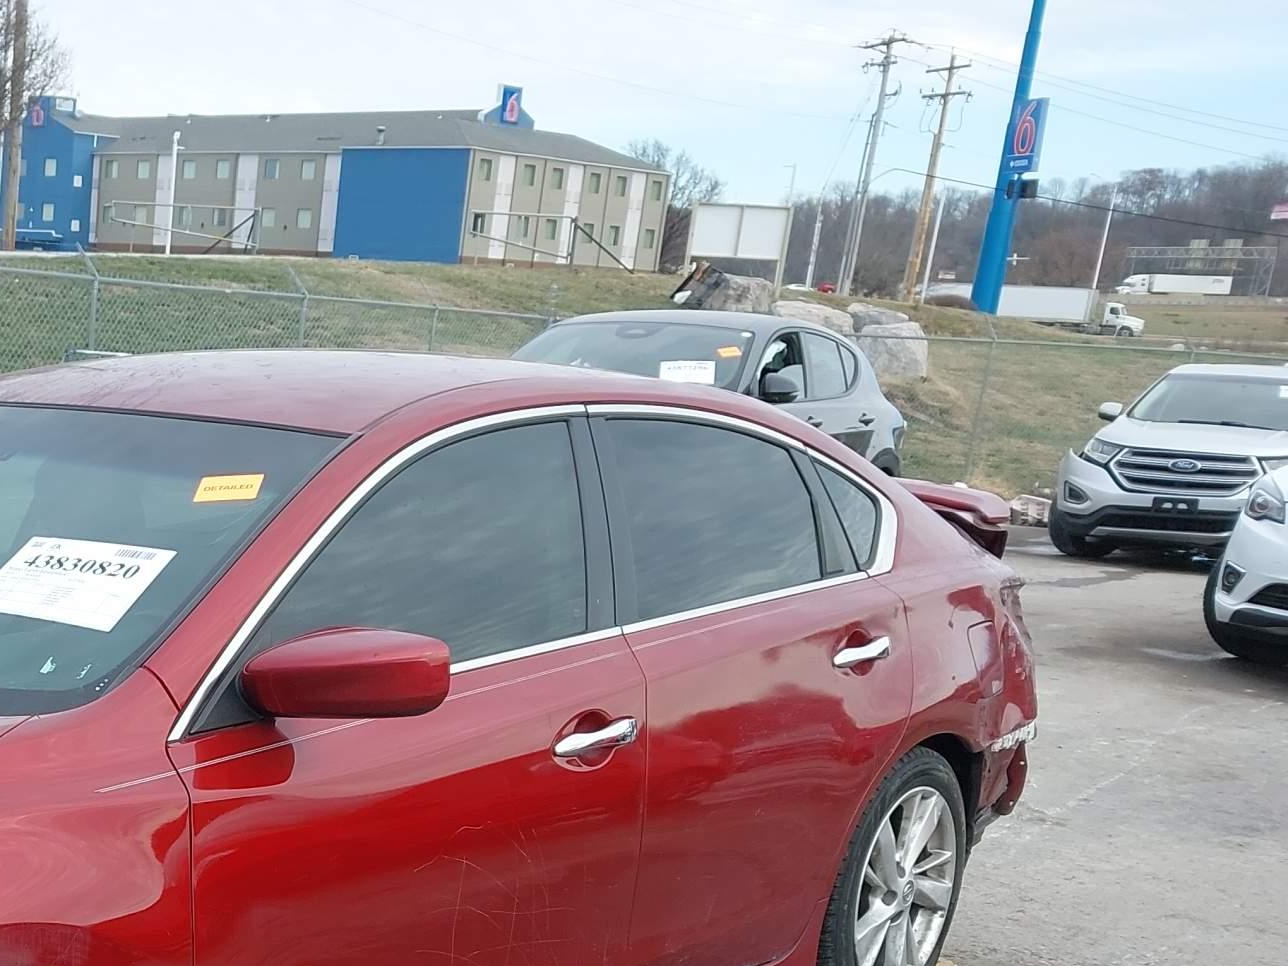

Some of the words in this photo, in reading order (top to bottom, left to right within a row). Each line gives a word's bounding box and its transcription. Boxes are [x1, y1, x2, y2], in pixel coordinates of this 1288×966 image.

[506, 92, 520, 122] 6
[1014, 100, 1037, 156] 6
[203, 483, 254, 492] DETAILED
[23, 553, 141, 580] 43830820
